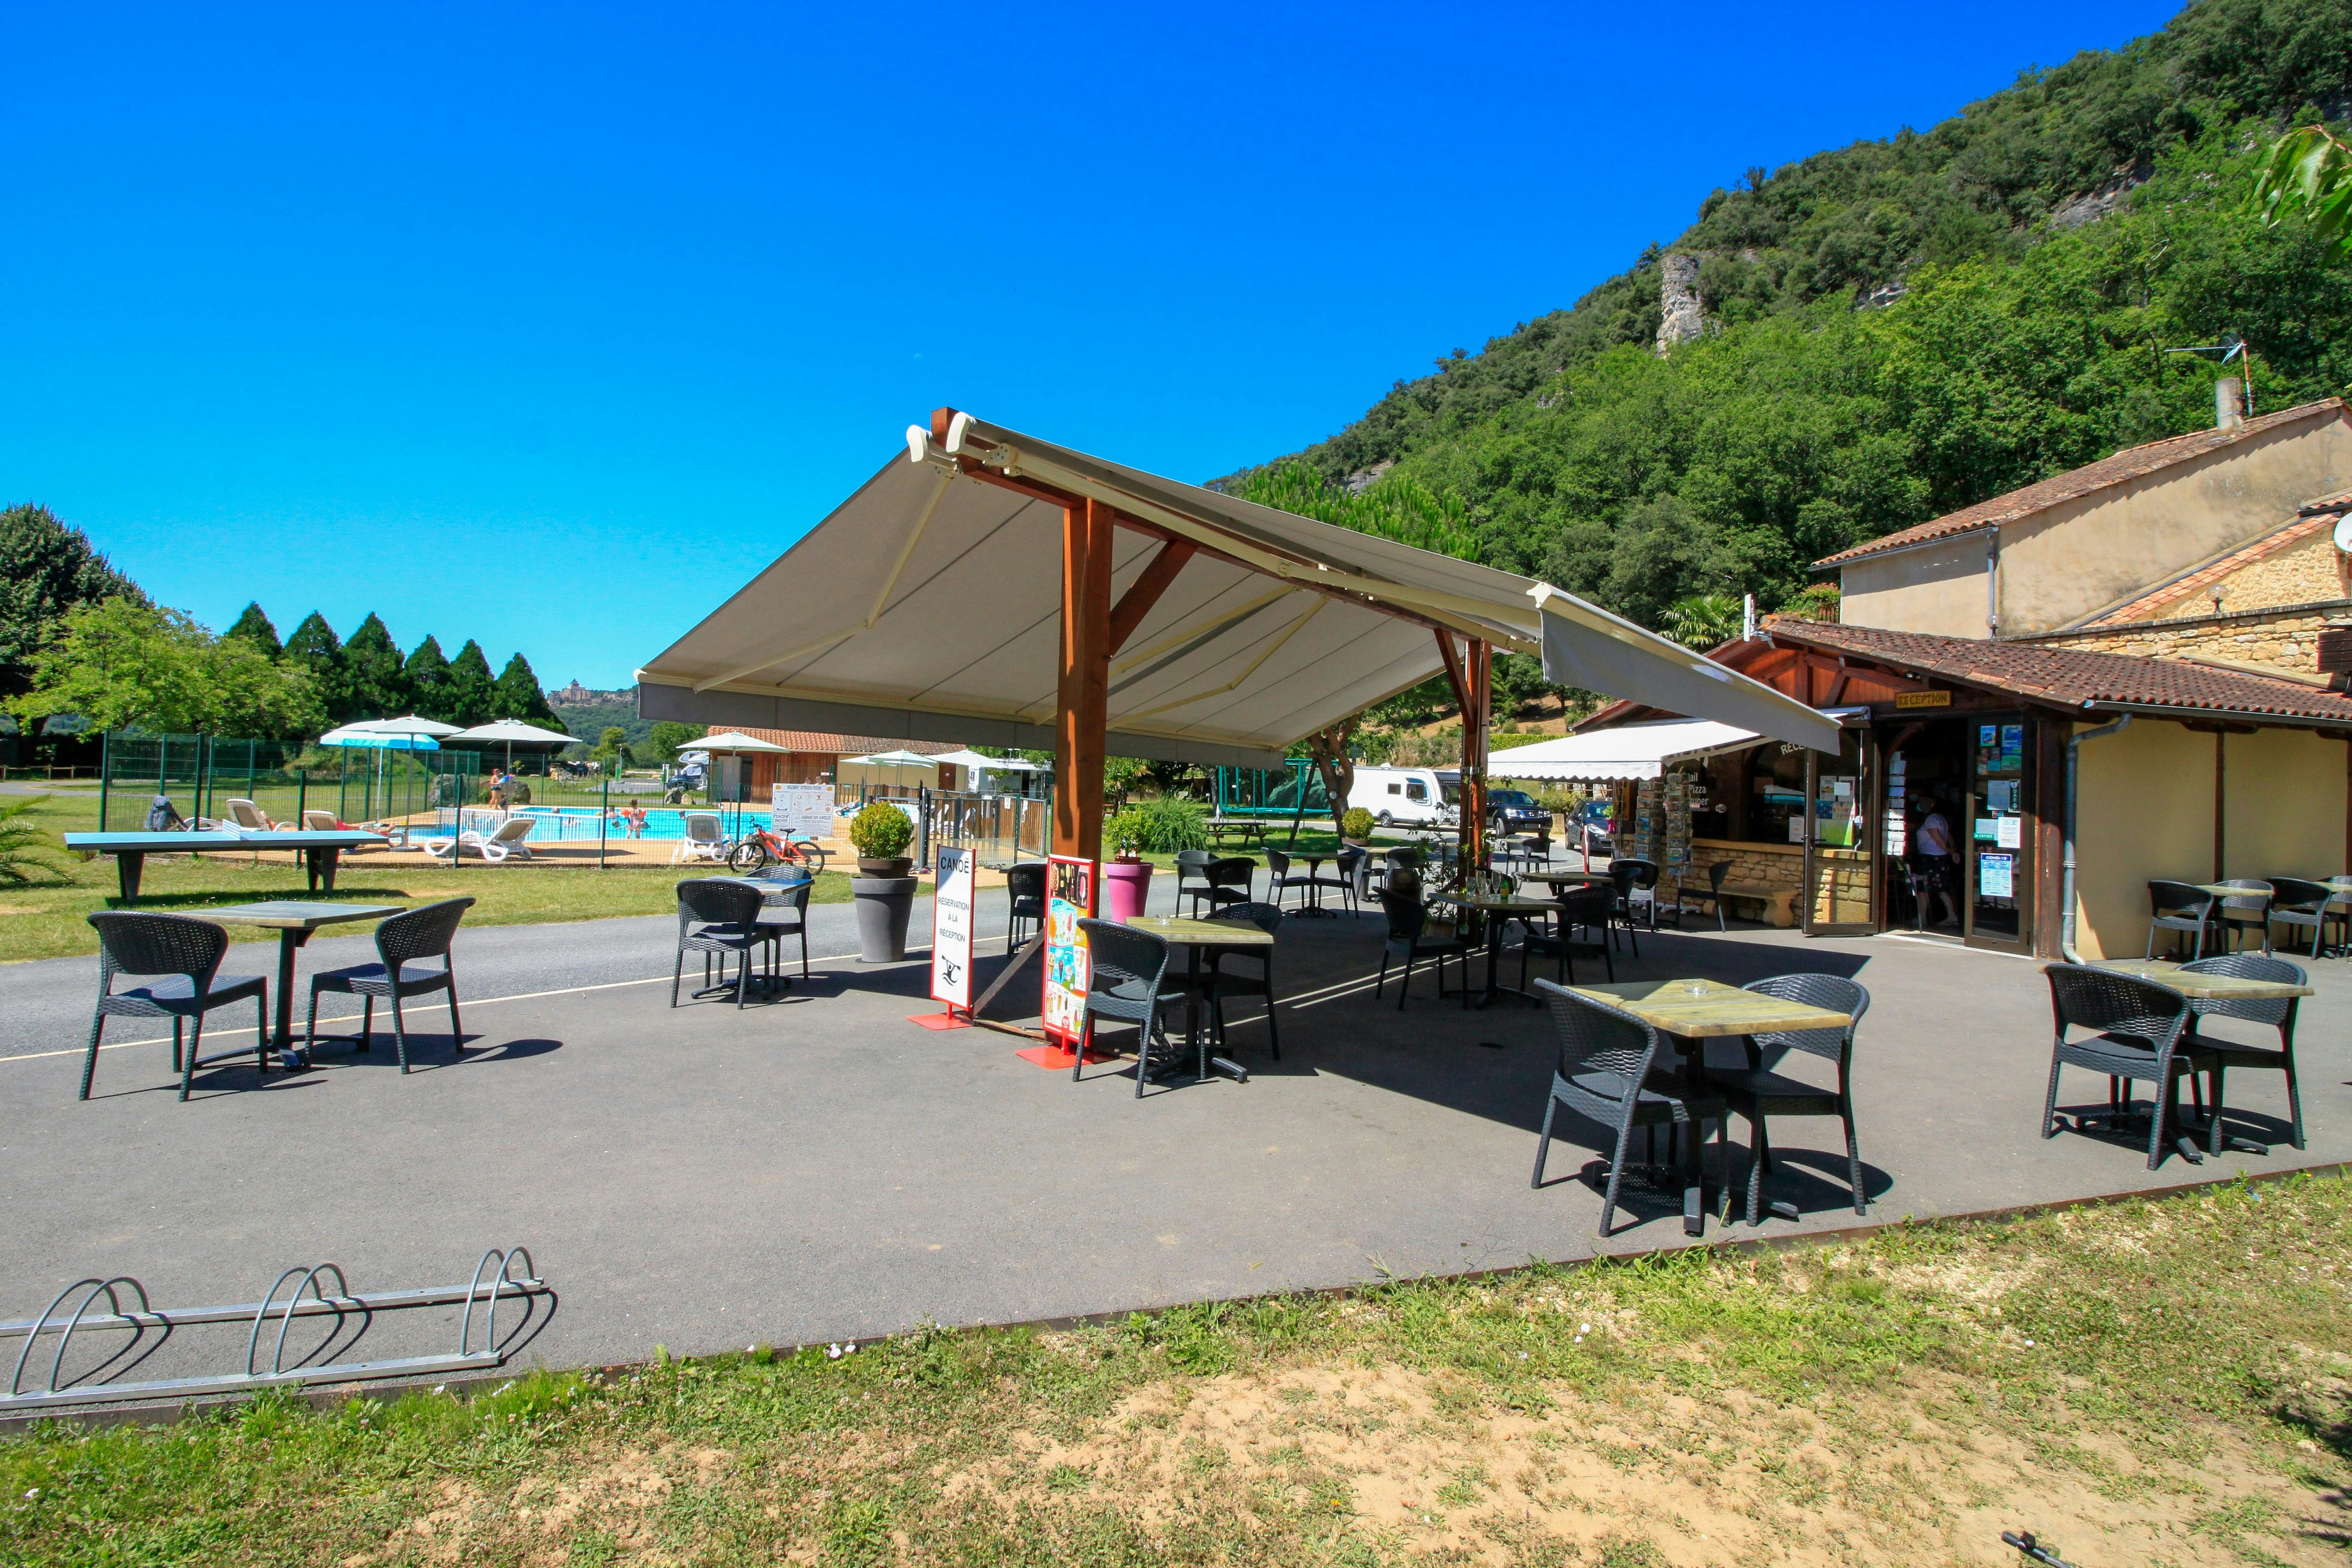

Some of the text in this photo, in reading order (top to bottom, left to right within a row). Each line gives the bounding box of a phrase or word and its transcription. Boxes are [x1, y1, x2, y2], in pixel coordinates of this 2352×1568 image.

[1899, 694, 1947, 705] RECEPTION
[1688, 784, 1706, 793] Pizza
[941, 857, 970, 874] CANOË
[938, 896, 969, 911] RÉSERVATION
[948, 911, 951, 921] À
[939, 927, 966, 942] RÉCEPTION
